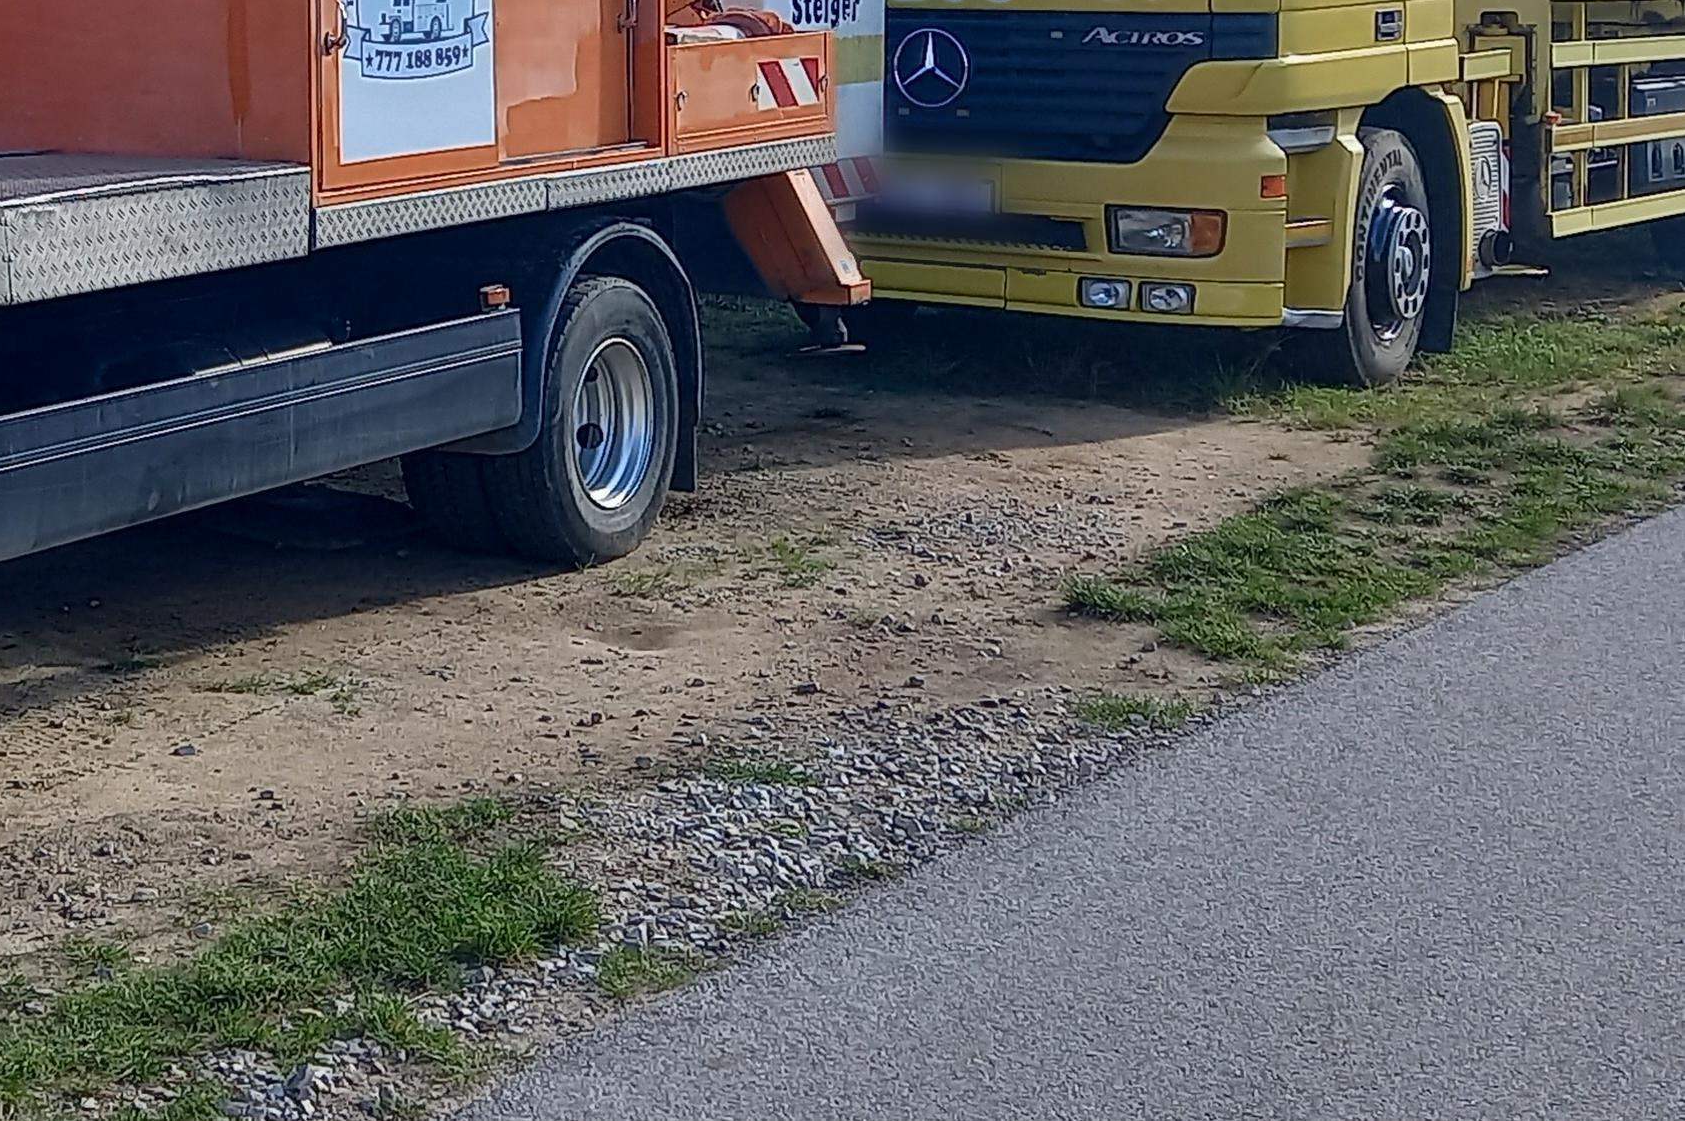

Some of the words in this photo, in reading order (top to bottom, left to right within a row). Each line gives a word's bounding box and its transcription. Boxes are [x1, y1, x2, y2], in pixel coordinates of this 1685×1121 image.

[374, 49, 403, 72] 777
[405, 50, 435, 70] 188
[435, 47, 462, 68] 859
